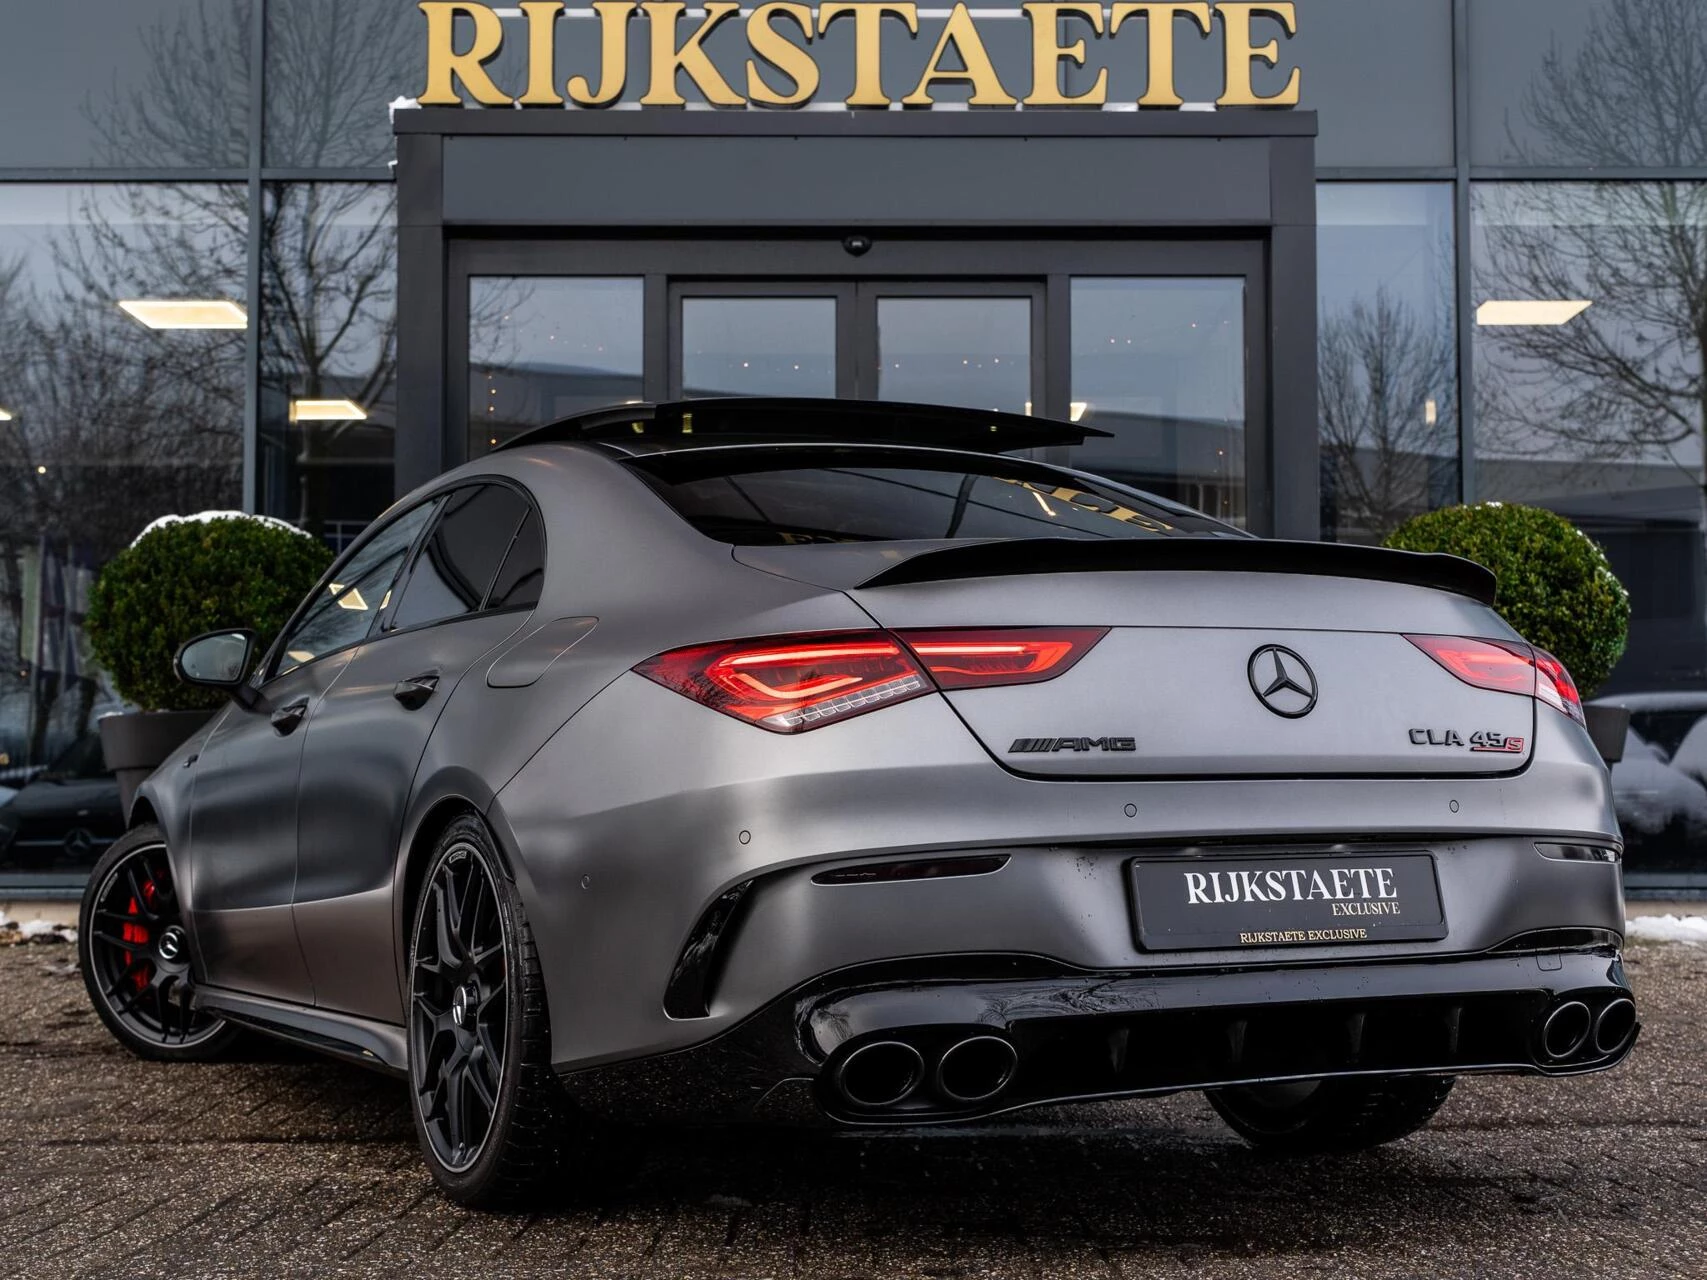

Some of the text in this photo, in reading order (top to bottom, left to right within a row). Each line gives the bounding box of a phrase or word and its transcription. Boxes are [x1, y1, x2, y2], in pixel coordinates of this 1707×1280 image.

[416, 1, 1301, 106] RIJKSTAETE
[1051, 736, 1137, 752] AMG
[1408, 728, 1465, 746] CLA
[1183, 868, 1398, 904] RIJKSTAETE
[1331, 901, 1401, 916] EXCLUSIVE
[1240, 928, 1368, 943] RIJKSTAETE EXCLUSIVE
